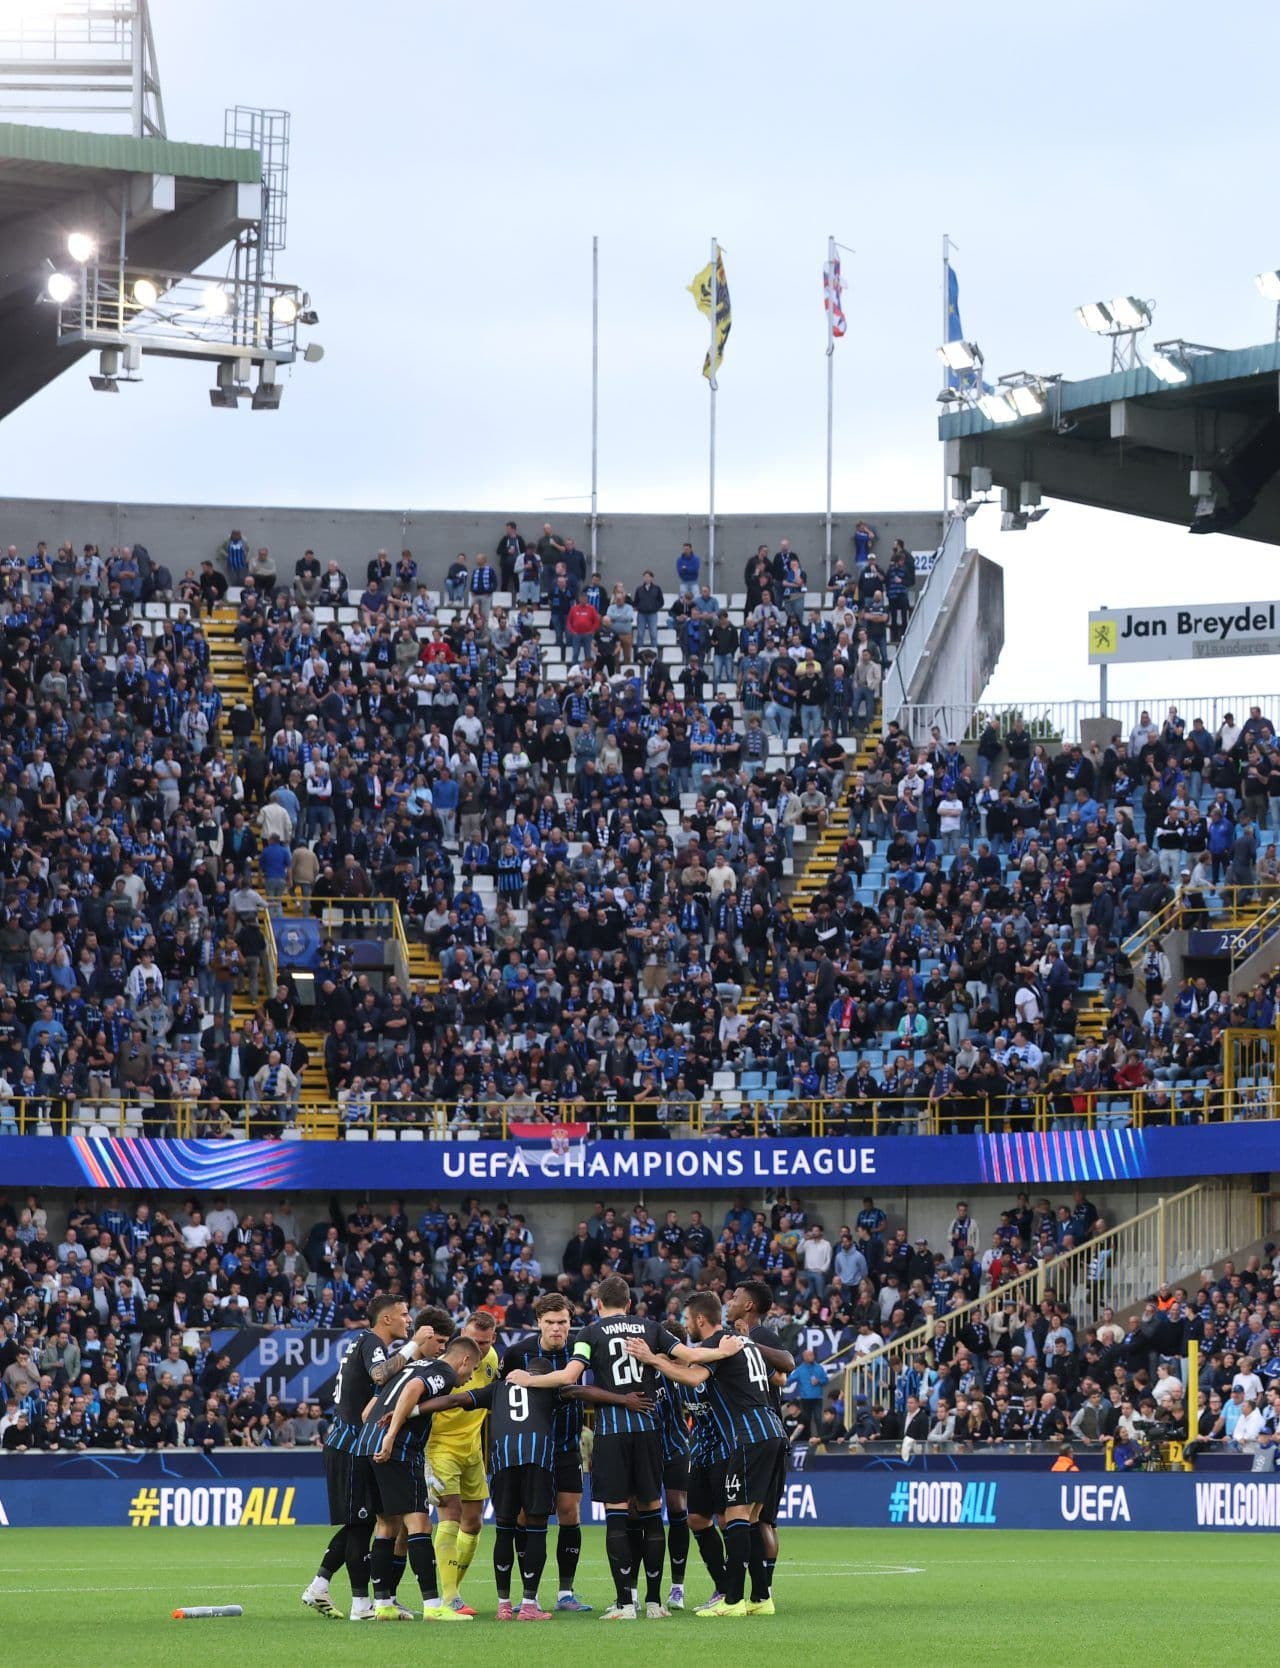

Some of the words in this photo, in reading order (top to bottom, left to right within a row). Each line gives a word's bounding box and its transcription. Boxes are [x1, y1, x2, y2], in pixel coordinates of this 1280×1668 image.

[1121, 614, 1167, 638] Jan
[1177, 608, 1276, 640] Breydel
[443, 1151, 530, 1178] UEFA
[541, 1149, 744, 1177] CHAMPIONS
[754, 1148, 876, 1175] LEAGUE
[601, 1322, 646, 1335] VANAKEN
[508, 1385, 530, 1422] 9
[128, 1486, 296, 1527] #FOOTBALL
[888, 1481, 997, 1524] #FOOTBALL
[1061, 1485, 1131, 1522] UEFA
